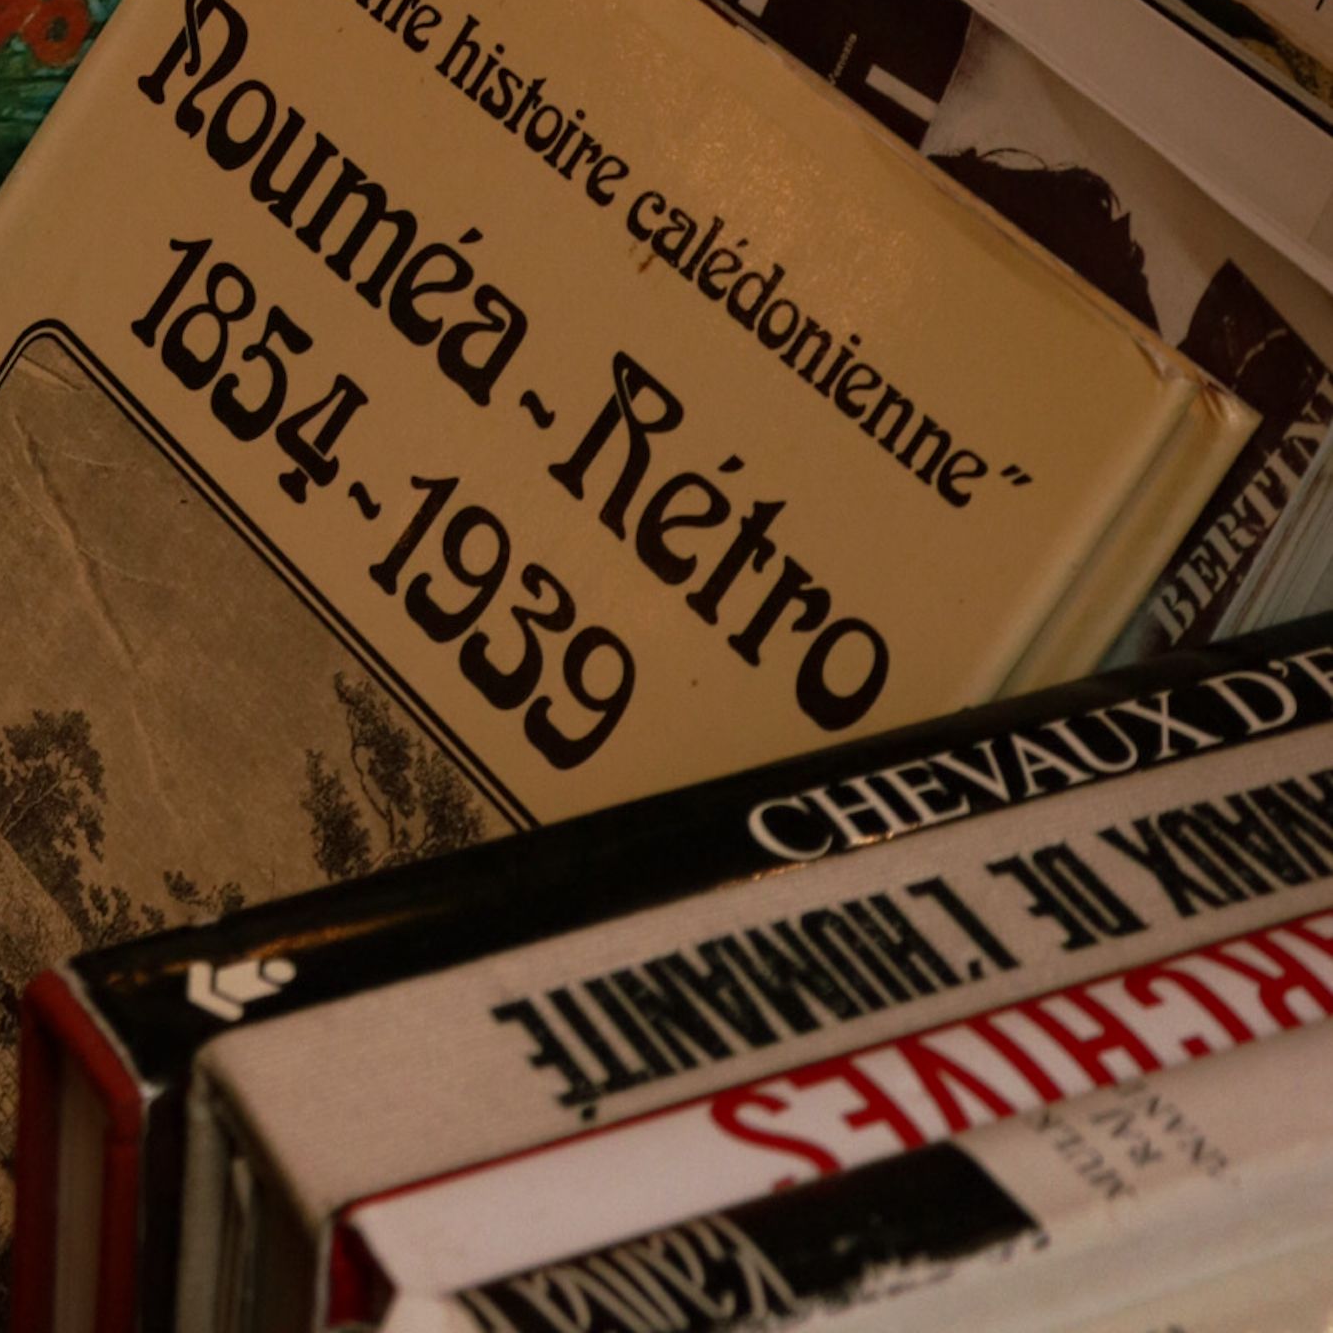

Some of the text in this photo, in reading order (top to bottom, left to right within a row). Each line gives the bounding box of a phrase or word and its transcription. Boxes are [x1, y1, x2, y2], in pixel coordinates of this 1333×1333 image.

[435, 15, 630, 209] histoire
[746, 687, 1225, 862] CHEVAUX
[985, 842, 1149, 951] DE
[491, 877, 1019, 1121] L'HUMANITÉ
